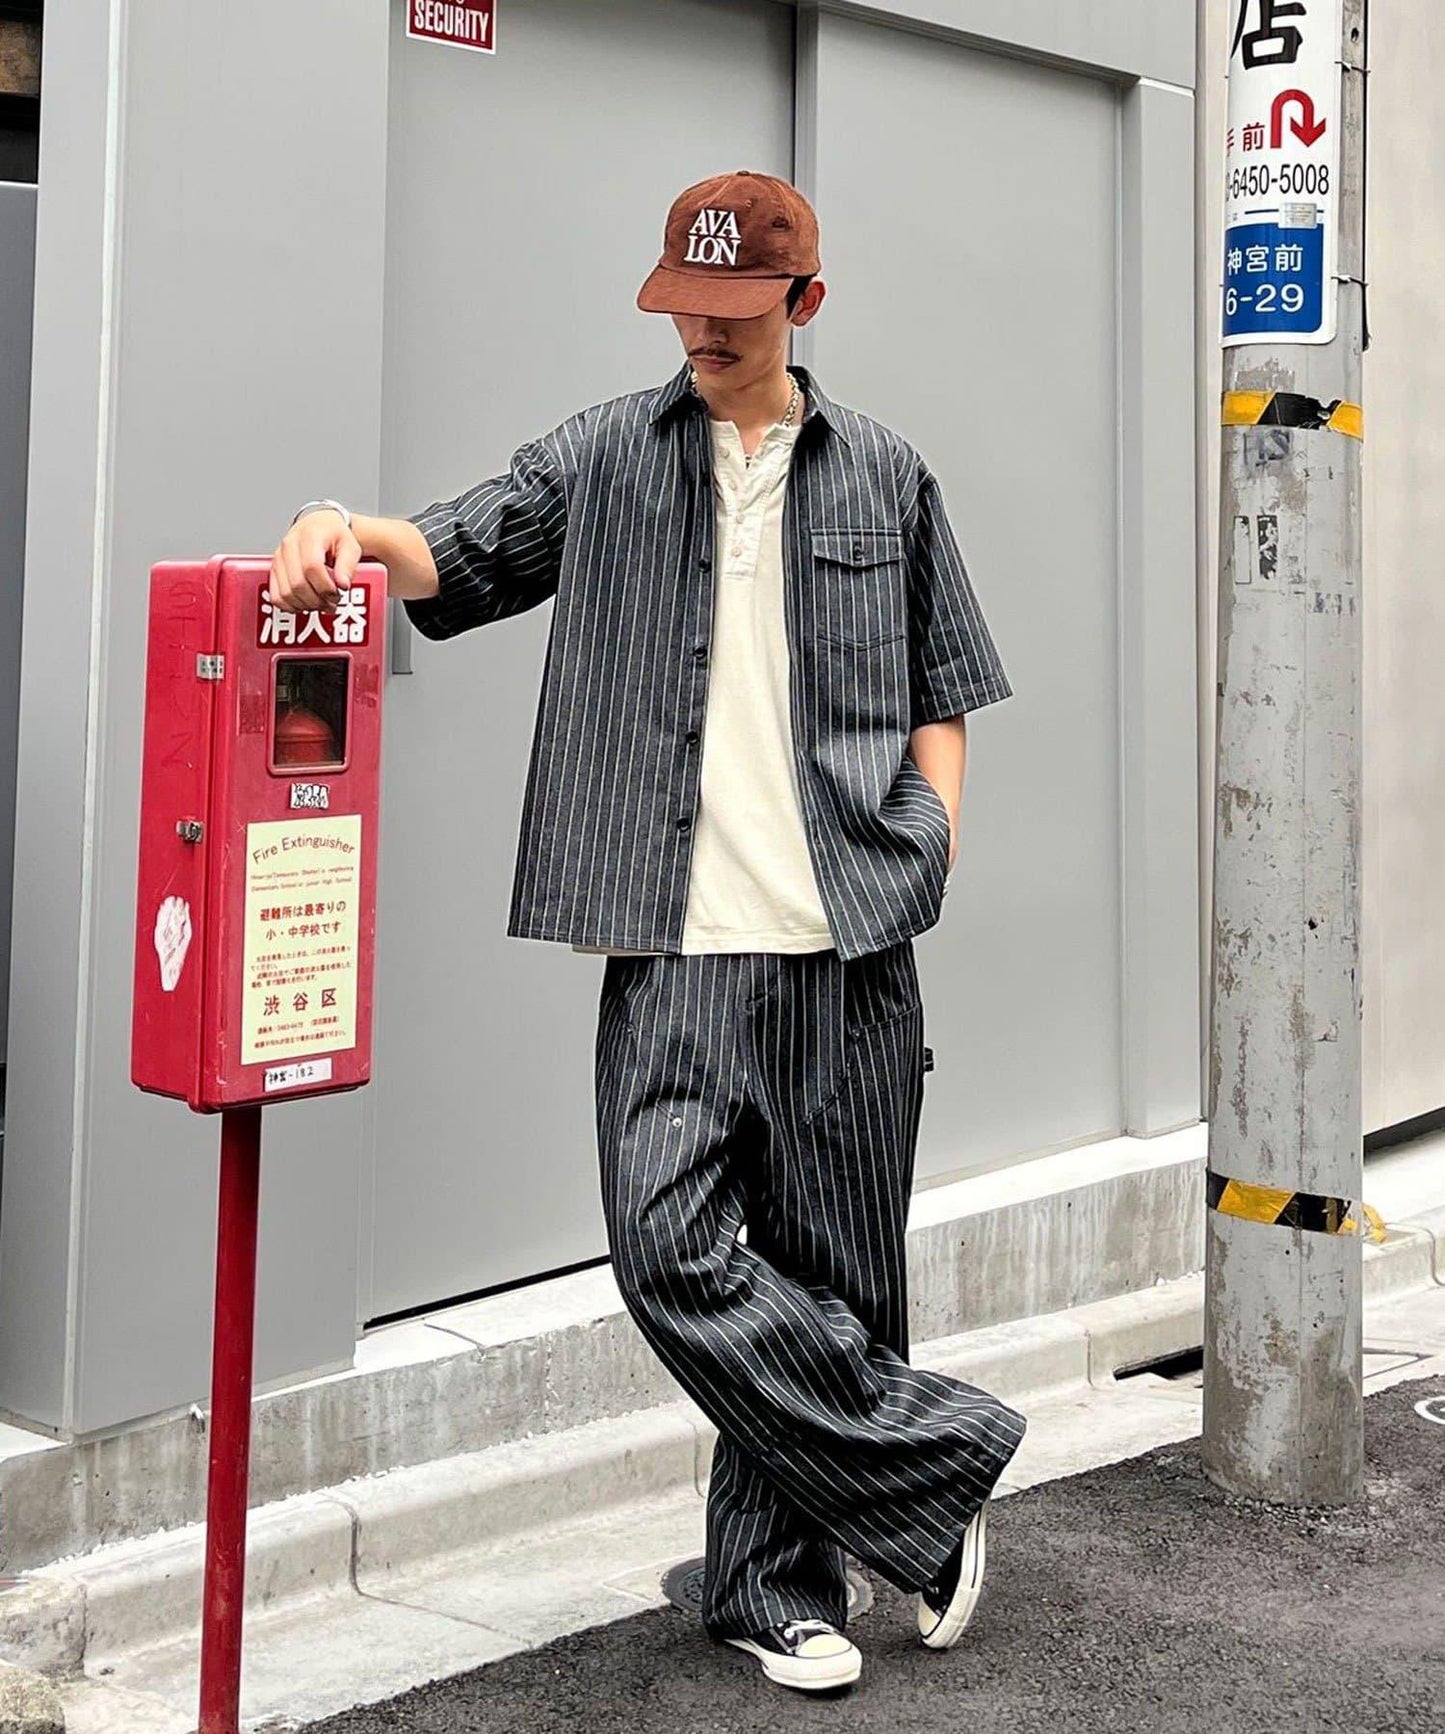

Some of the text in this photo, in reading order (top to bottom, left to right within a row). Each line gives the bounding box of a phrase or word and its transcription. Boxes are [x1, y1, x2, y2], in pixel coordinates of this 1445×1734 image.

[414, 0, 489, 42] SECURITY
[688, 208, 742, 239] AVA
[683, 235, 742, 267] LON
[1227, 243, 1304, 276] 神宮前
[1225, 283, 1305, 316] 6-29
[252, 835, 355, 864] Fire Extinguisher
[266, 921, 341, 941] 小・中学校です
[263, 988, 337, 1016] 渋谷区
